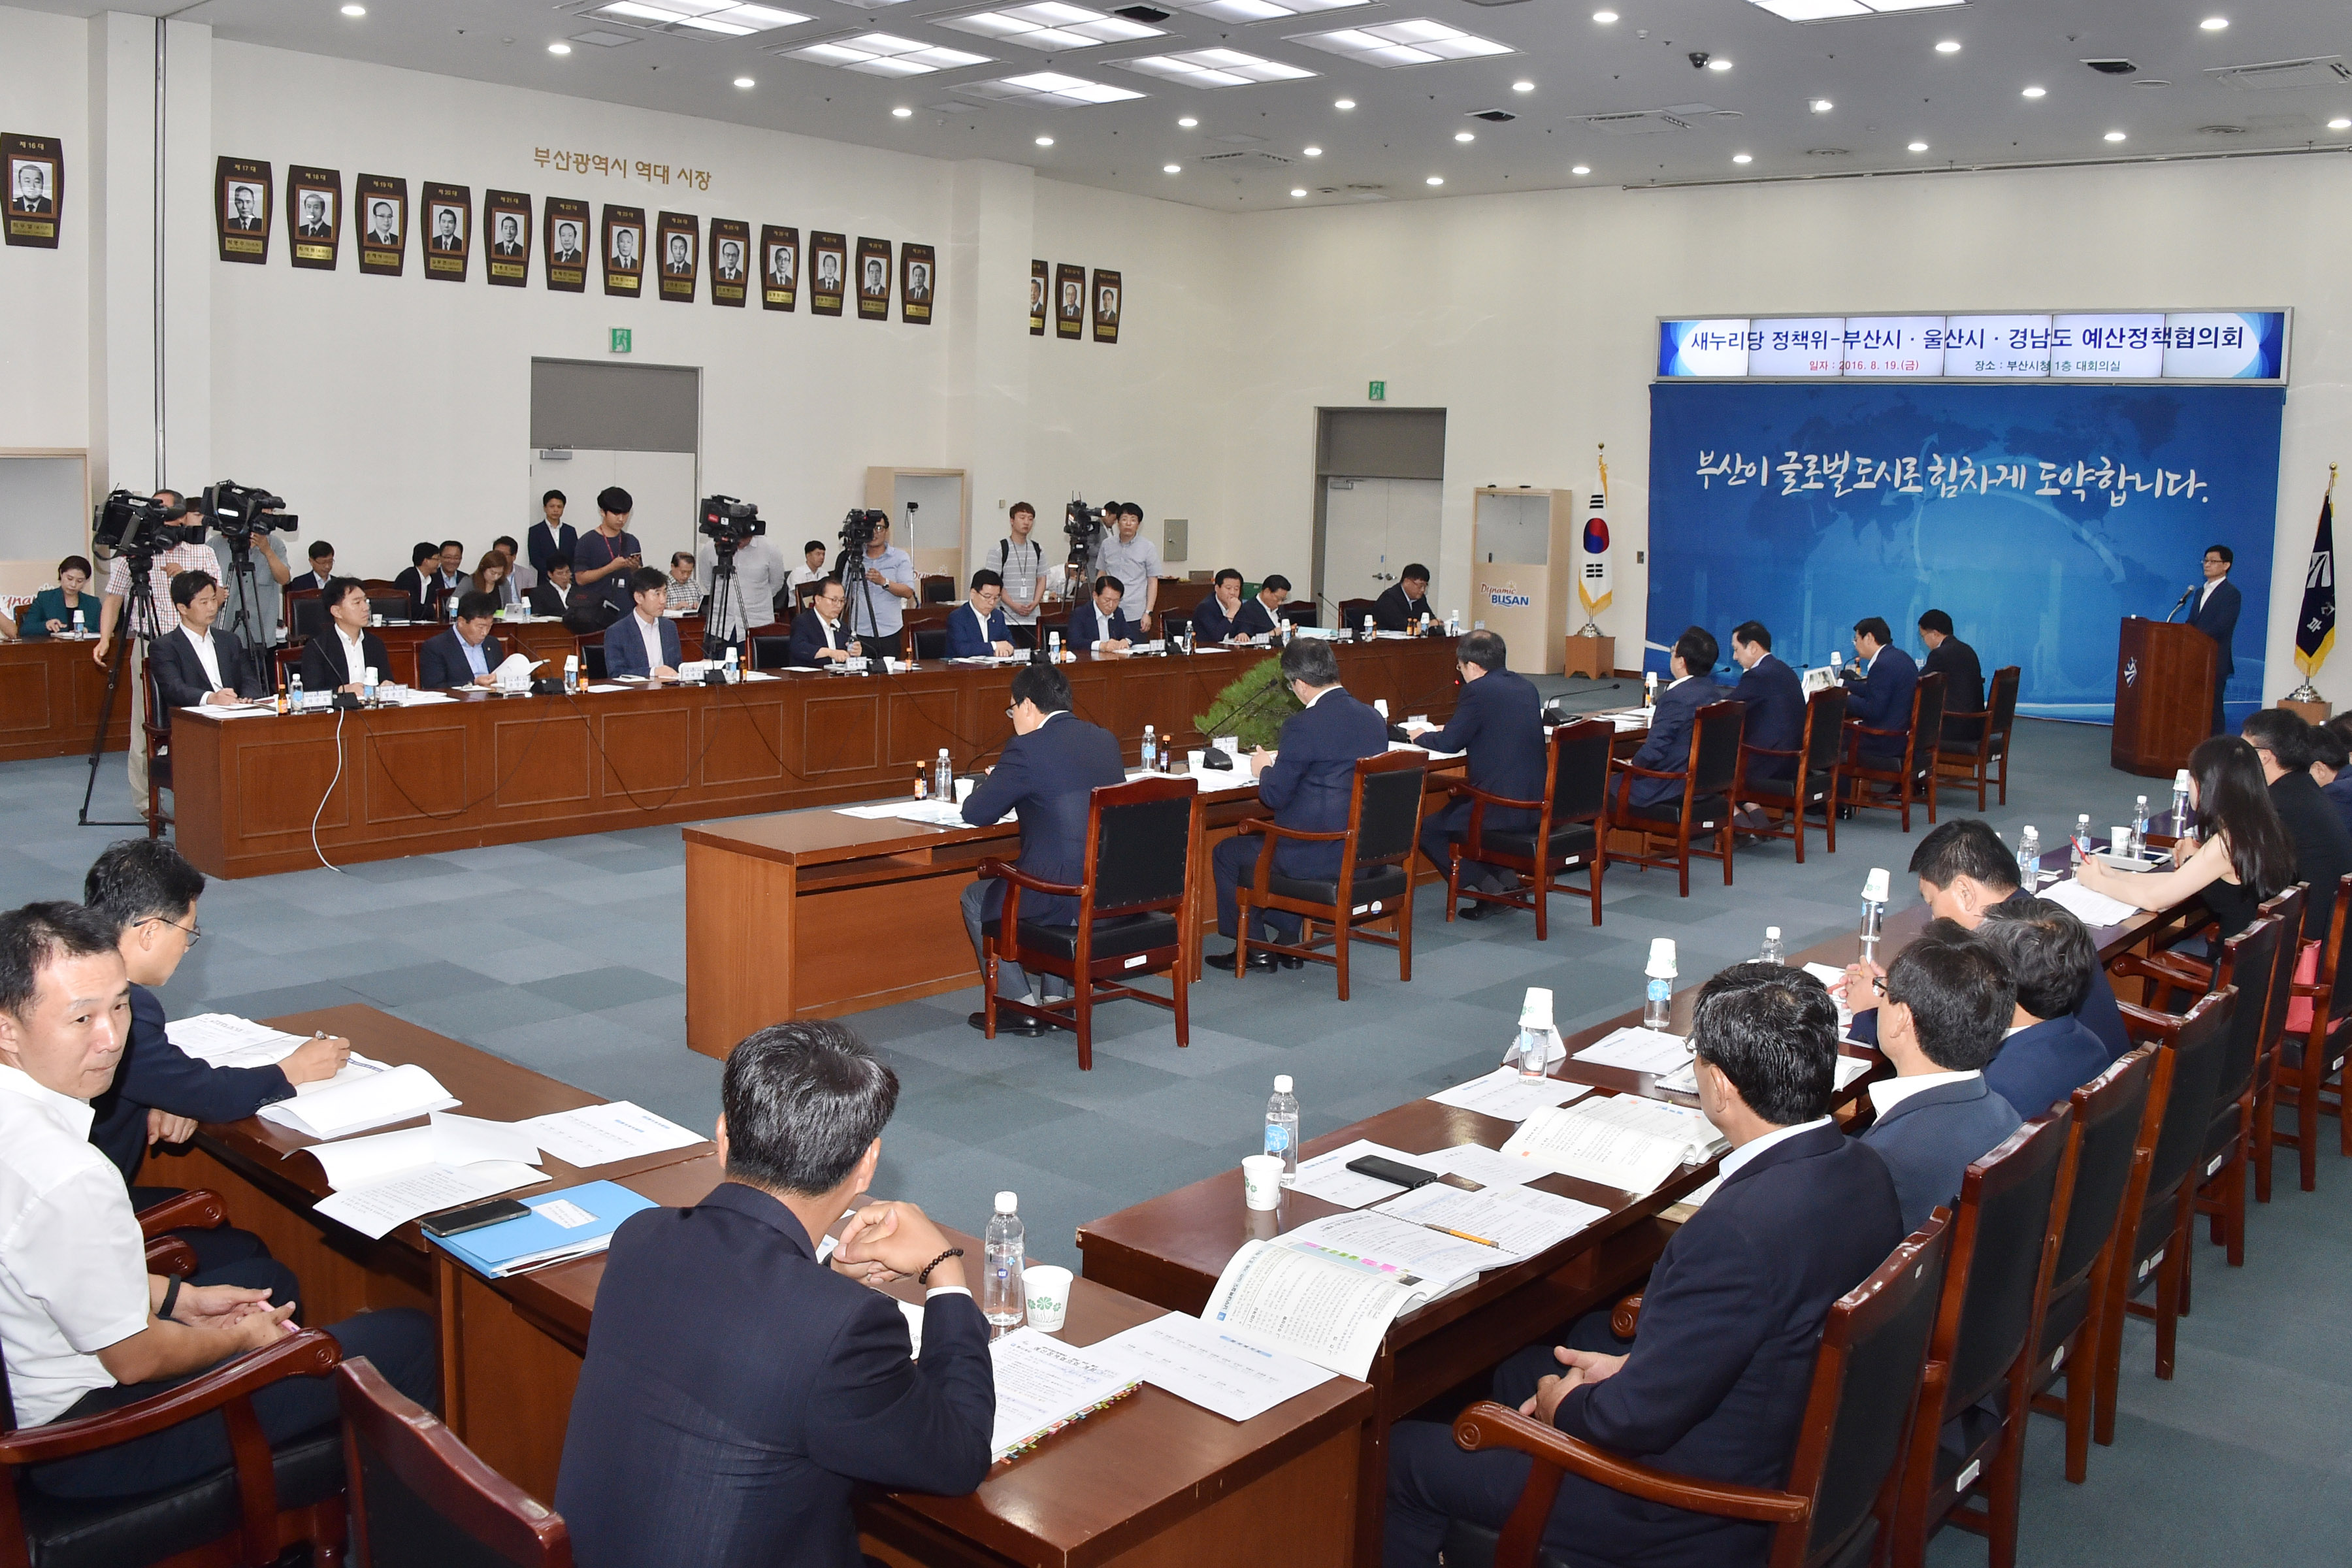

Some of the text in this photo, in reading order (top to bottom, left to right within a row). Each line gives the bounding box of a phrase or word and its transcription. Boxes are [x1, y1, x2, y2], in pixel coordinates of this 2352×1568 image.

[534, 147, 711, 191] 부산광역시 역대 시장
[1691, 331, 1765, 351] 새누리당
[1923, 328, 1985, 350] 울산시
[2008, 328, 2072, 350] 경남도
[2082, 325, 2243, 350] 예산정책협의회
[1809, 361, 1829, 371] 일자
[1838, 361, 1867, 370] 2016.
[1870, 361, 1880, 370] 8.
[1974, 361, 1995, 371] 장소
[2007, 360, 2050, 371] 부산시청
[2055, 361, 2072, 372] 1층
[2076, 361, 2121, 372] 대회의실
[1696, 450, 1769, 490] 부산이
[1927, 453, 2027, 498] 힘차게
[2035, 456, 2208, 508] 도약합니다.
[1480, 583, 1516, 598] Dynamic
[1492, 595, 1529, 606] BUSAN
